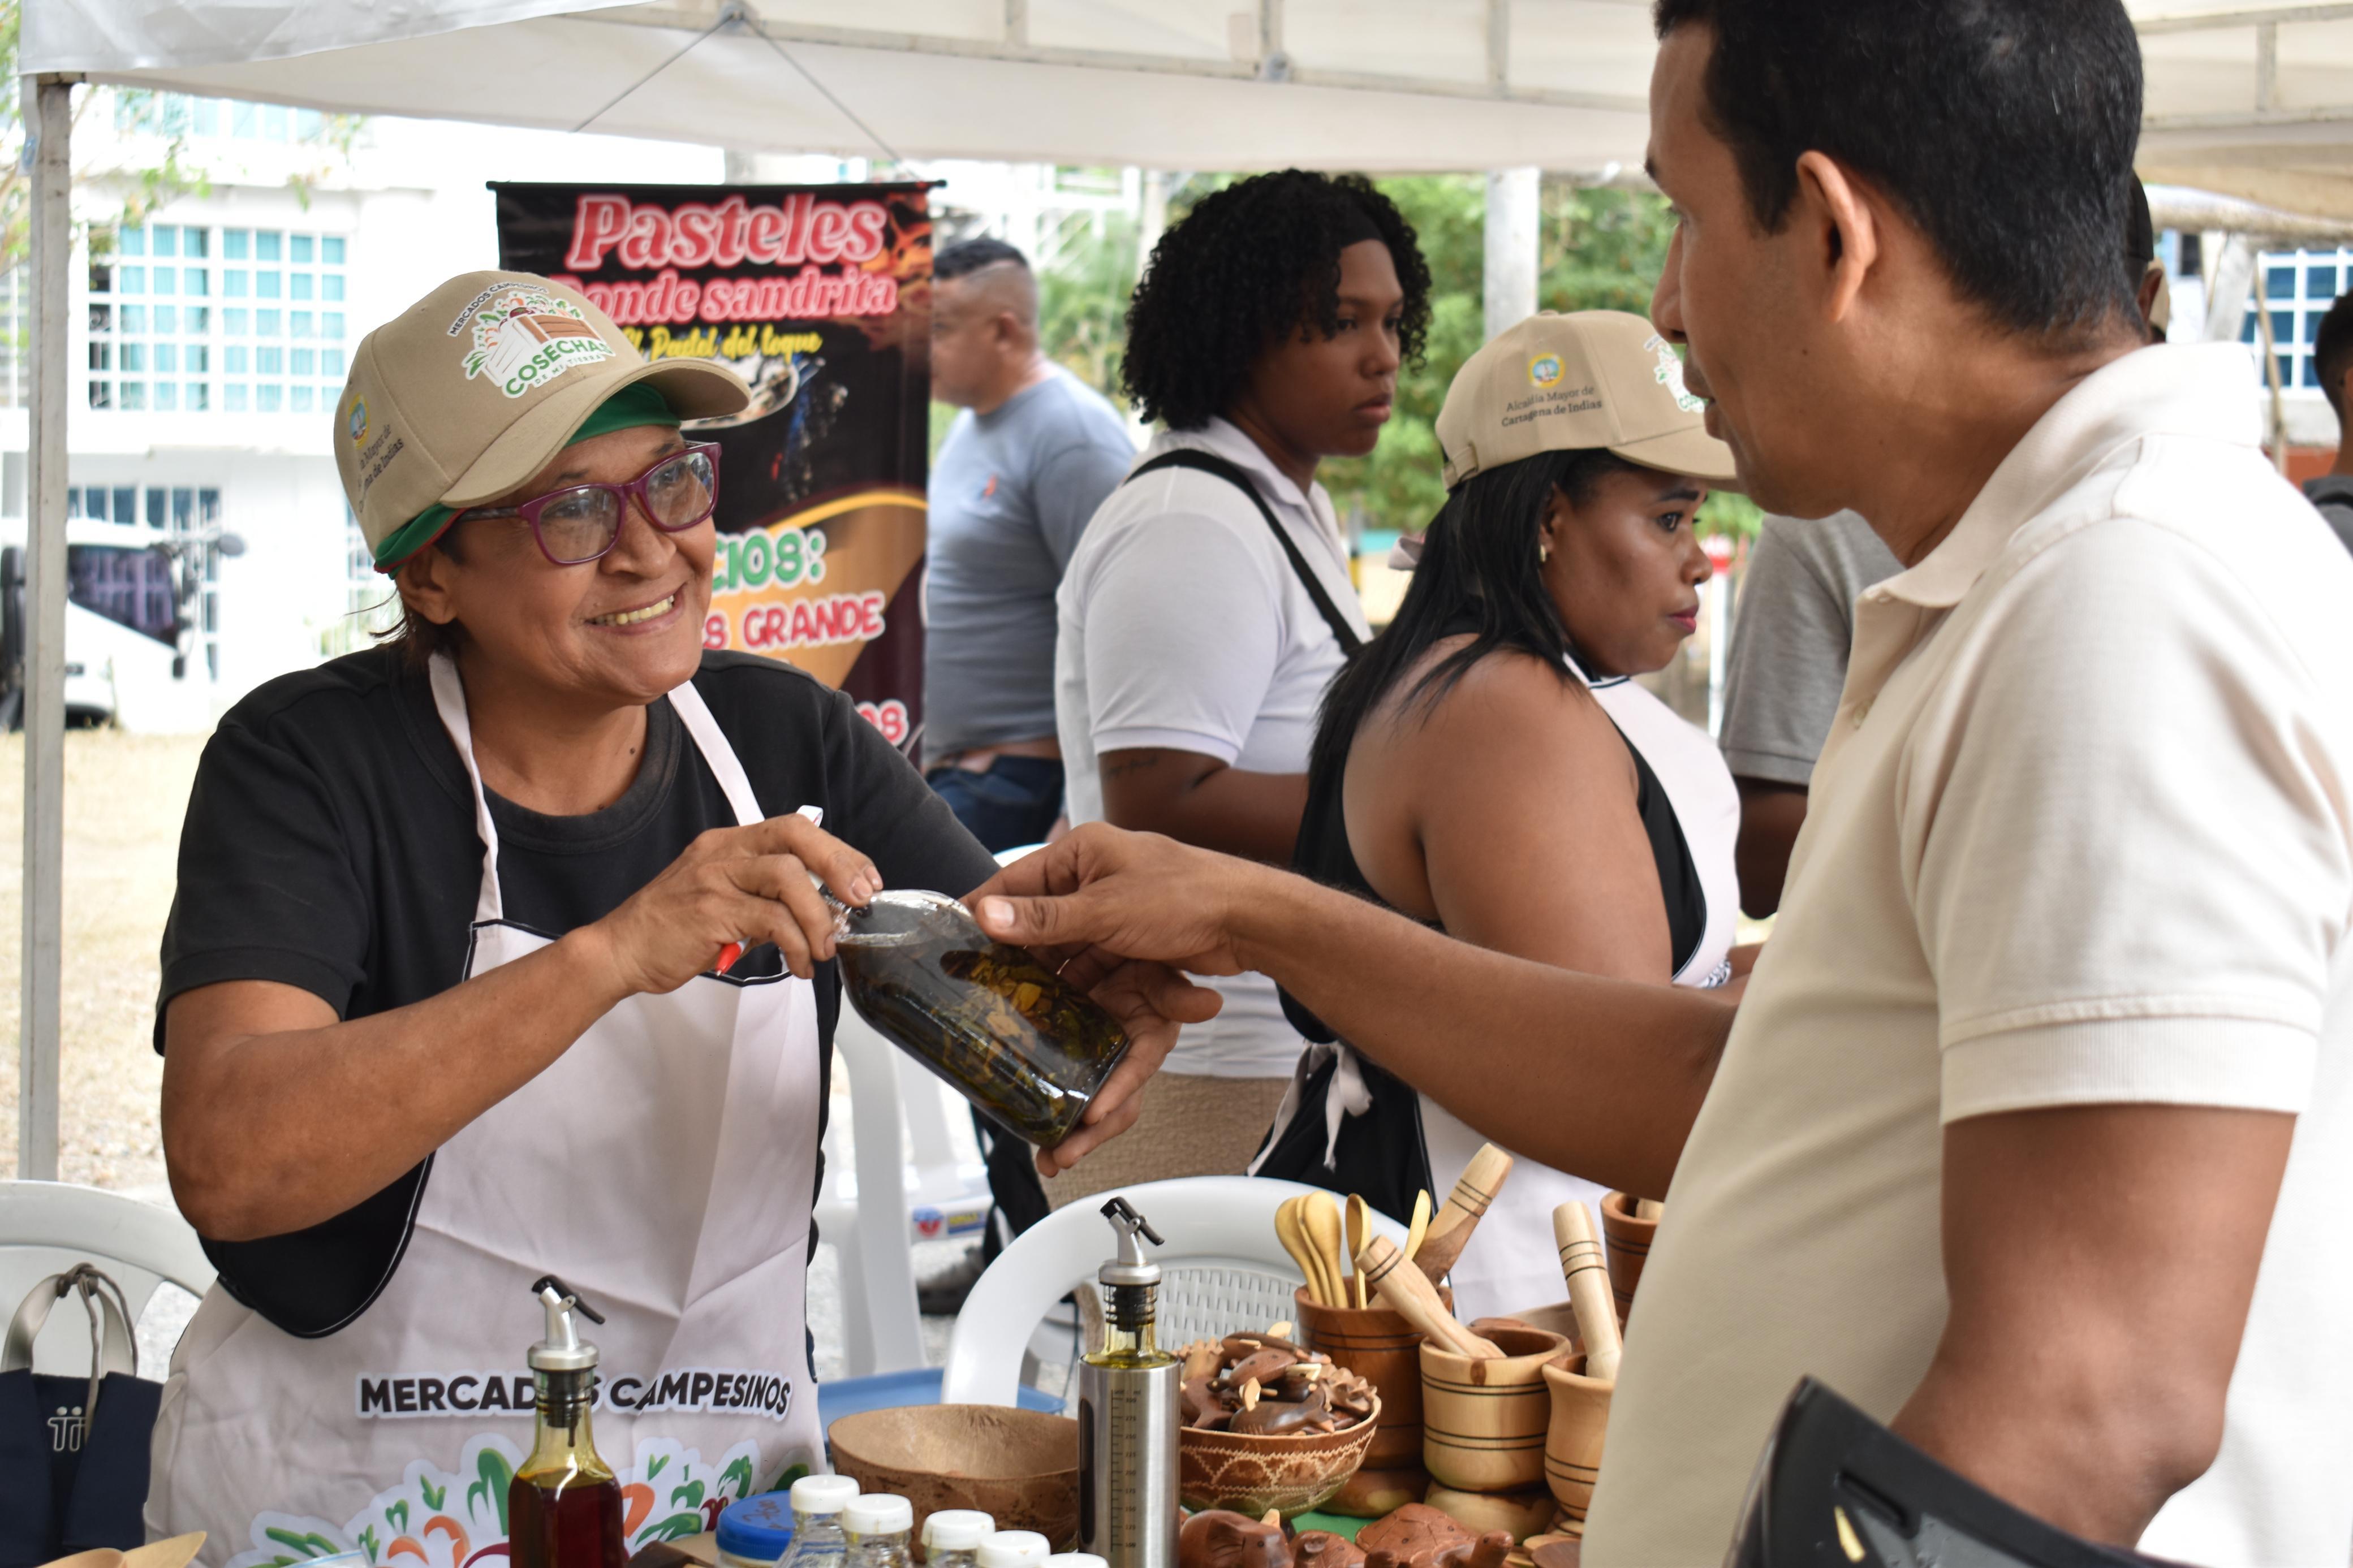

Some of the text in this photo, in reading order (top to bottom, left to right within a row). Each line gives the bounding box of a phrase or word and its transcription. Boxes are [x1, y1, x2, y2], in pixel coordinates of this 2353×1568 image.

[565, 193, 887, 270] Pasteles
[450, 292, 491, 335] MERCADOS
[700, 264, 898, 321] sandrita
[649, 326, 718, 360] Pastel
[722, 324, 757, 360] del
[506, 340, 614, 395] COSECHAS
[535, 354, 602, 385] DE MI TIERRA
[1502, 400, 1602, 427] Cartagena de Indias
[1547, 390, 1579, 401] Mayor
[1581, 386, 1594, 395] de
[744, 597, 882, 649] GRANDE
[361, 1372, 791, 1414] MERCADS CAMPESINOS
